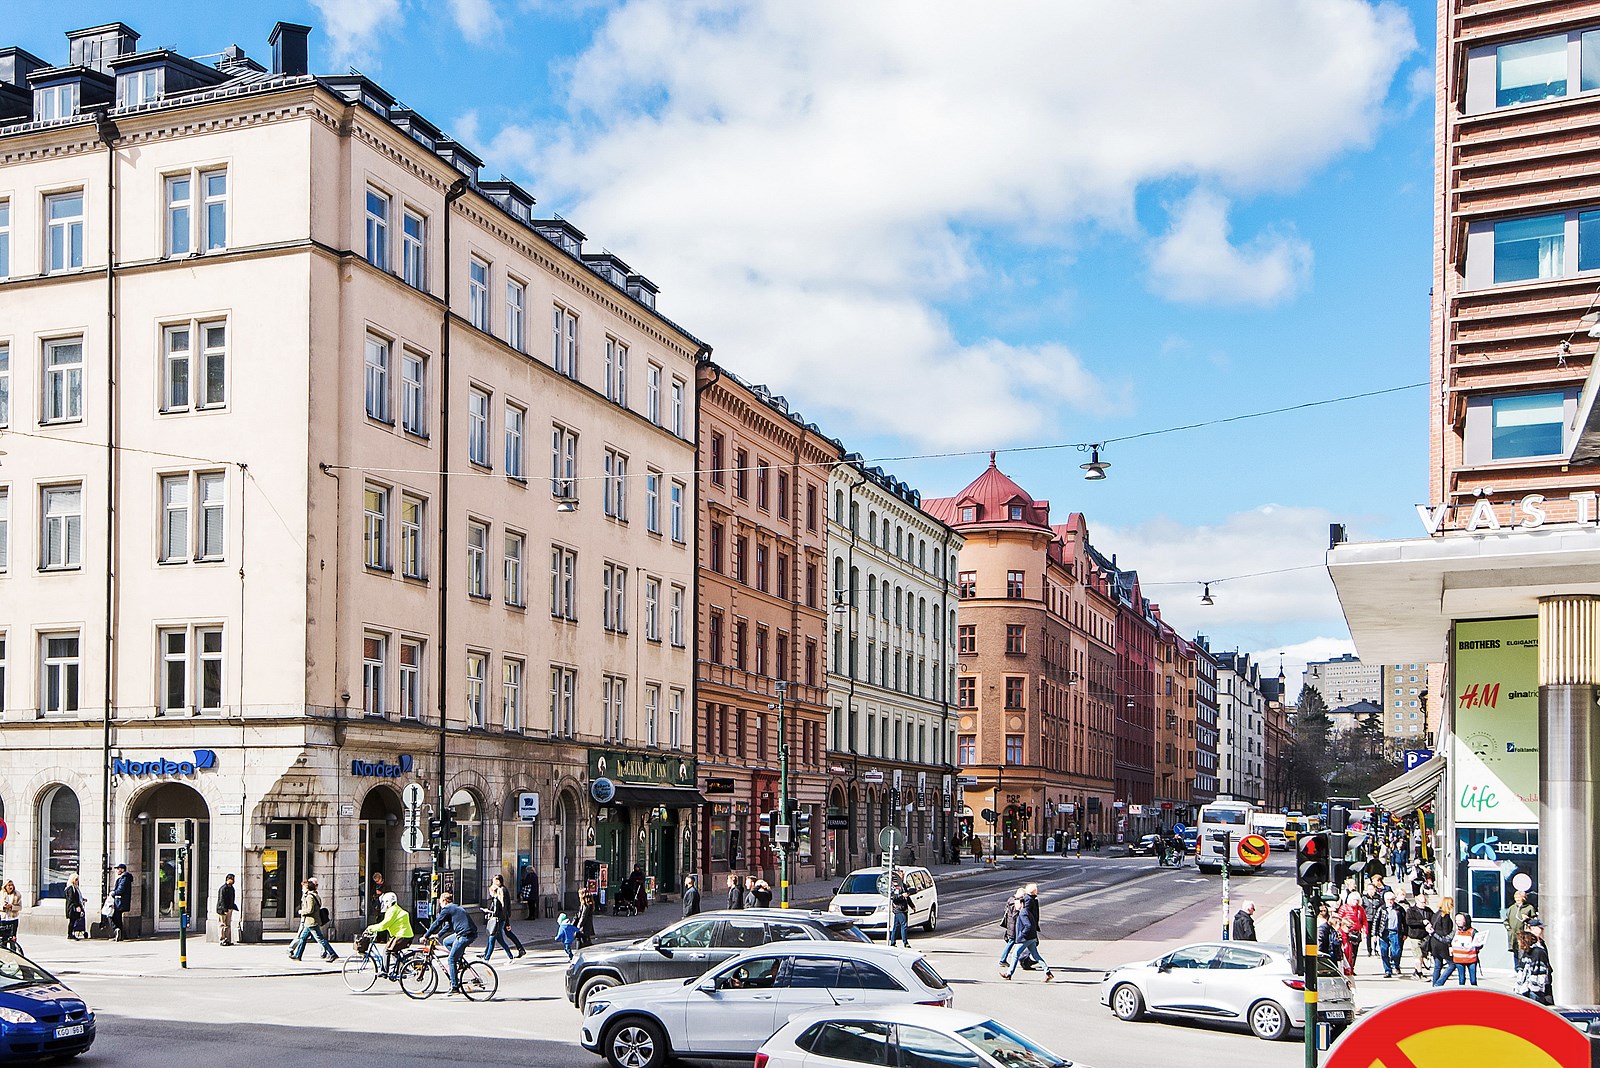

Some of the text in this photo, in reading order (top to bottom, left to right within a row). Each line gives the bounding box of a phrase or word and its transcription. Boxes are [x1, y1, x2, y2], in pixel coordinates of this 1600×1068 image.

[1415, 485, 1596, 535] VÄST
[1459, 639, 1500, 650] BROTHERS
[1459, 682, 1501, 709] H&M
[114, 757, 195, 775] Nordea
[353, 759, 401, 777] Nordea
[656, 763, 667, 777] INN
[1498, 841, 1539, 855] telenor
